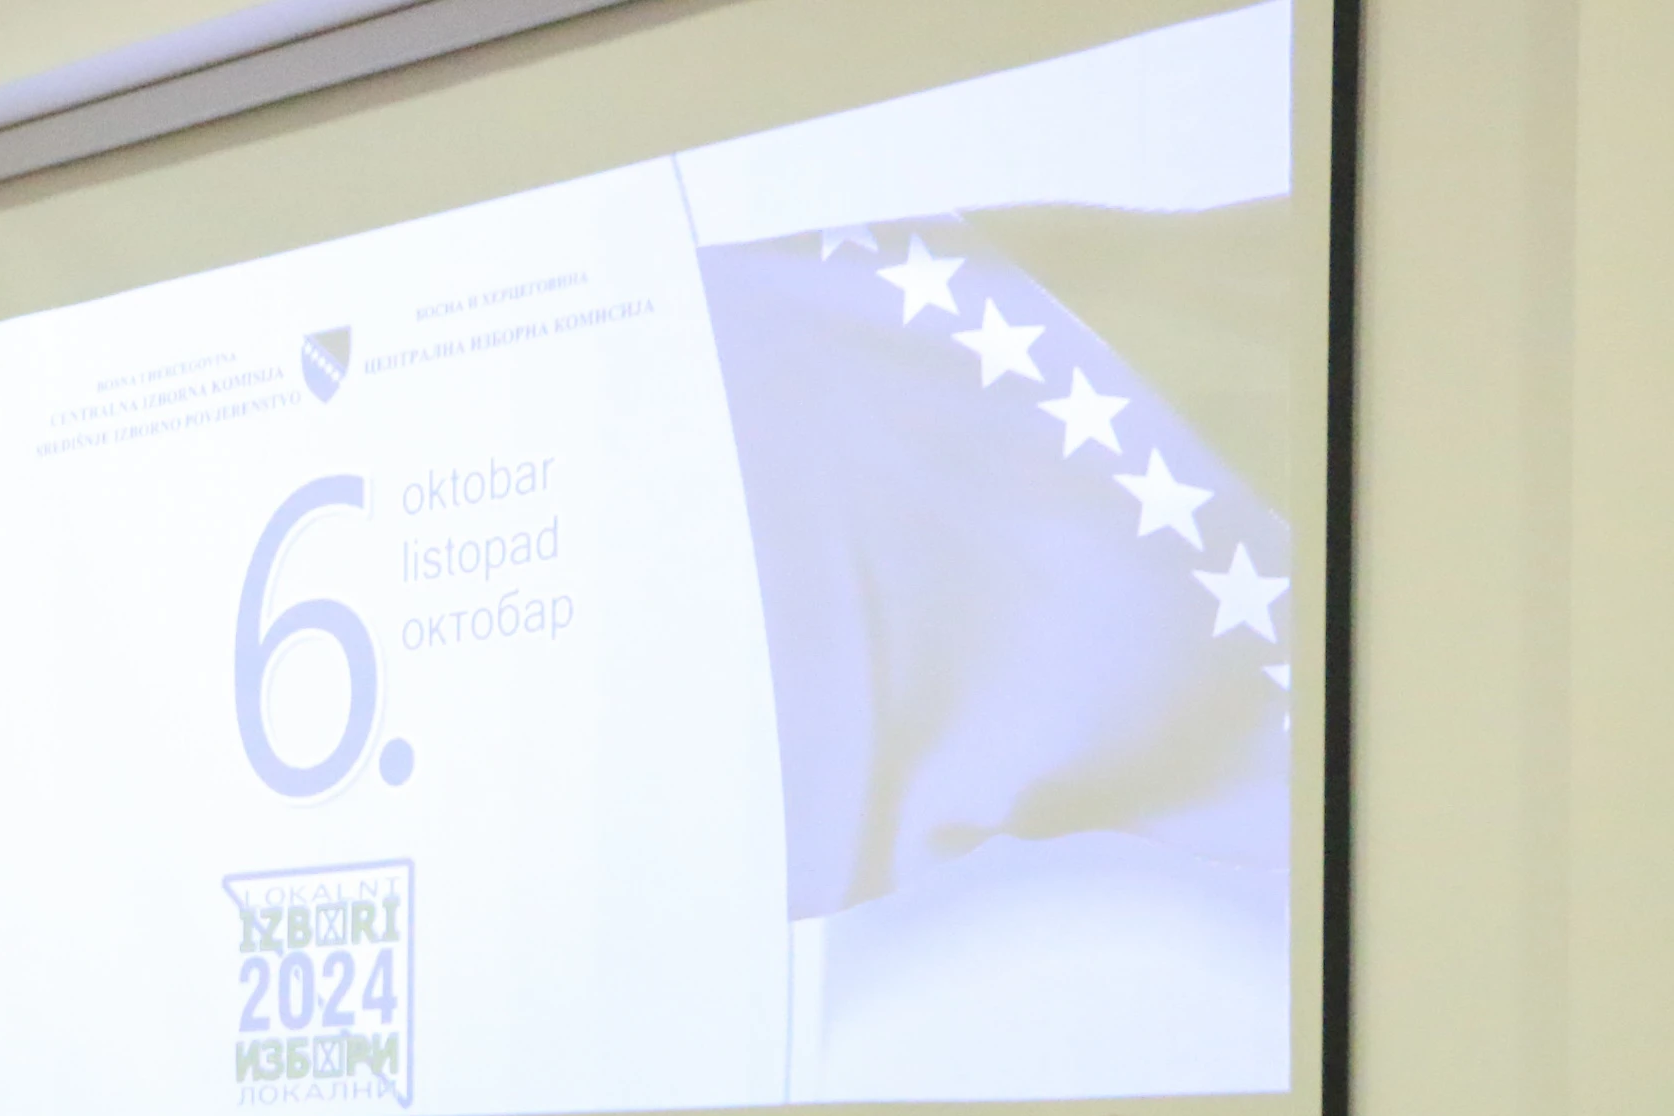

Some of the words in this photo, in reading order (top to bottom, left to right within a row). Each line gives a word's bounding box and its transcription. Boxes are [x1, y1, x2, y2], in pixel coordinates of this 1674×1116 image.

[364, 340, 465, 375] ЦЕНТРАЛНА
[470, 321, 549, 352] ИЗБОРНА
[554, 297, 655, 334] КОМИСИЈА
[416, 300, 464, 322] БОСНА
[467, 295, 478, 309] И
[50, 400, 138, 427] CENTRALNA
[142, 383, 208, 410] IZBORNA
[211, 365, 285, 394] KOMISIJA
[96, 373, 137, 393] BOSNA
[148, 351, 237, 383] HERCEGOVINA
[36, 430, 108, 458] SREDIŠNJE
[114, 417, 182, 442] IZBORNO
[184, 390, 302, 428] POVJERENSTVO
[402, 456, 556, 515] oktobar
[402, 514, 560, 583] listopad
[234, 473, 415, 799] 6.
[402, 588, 575, 650] октобар
[242, 876, 401, 907] LOKALNI
[238, 947, 398, 1032] 2024
[237, 1079, 399, 1106] ЛОКАЛНИ
